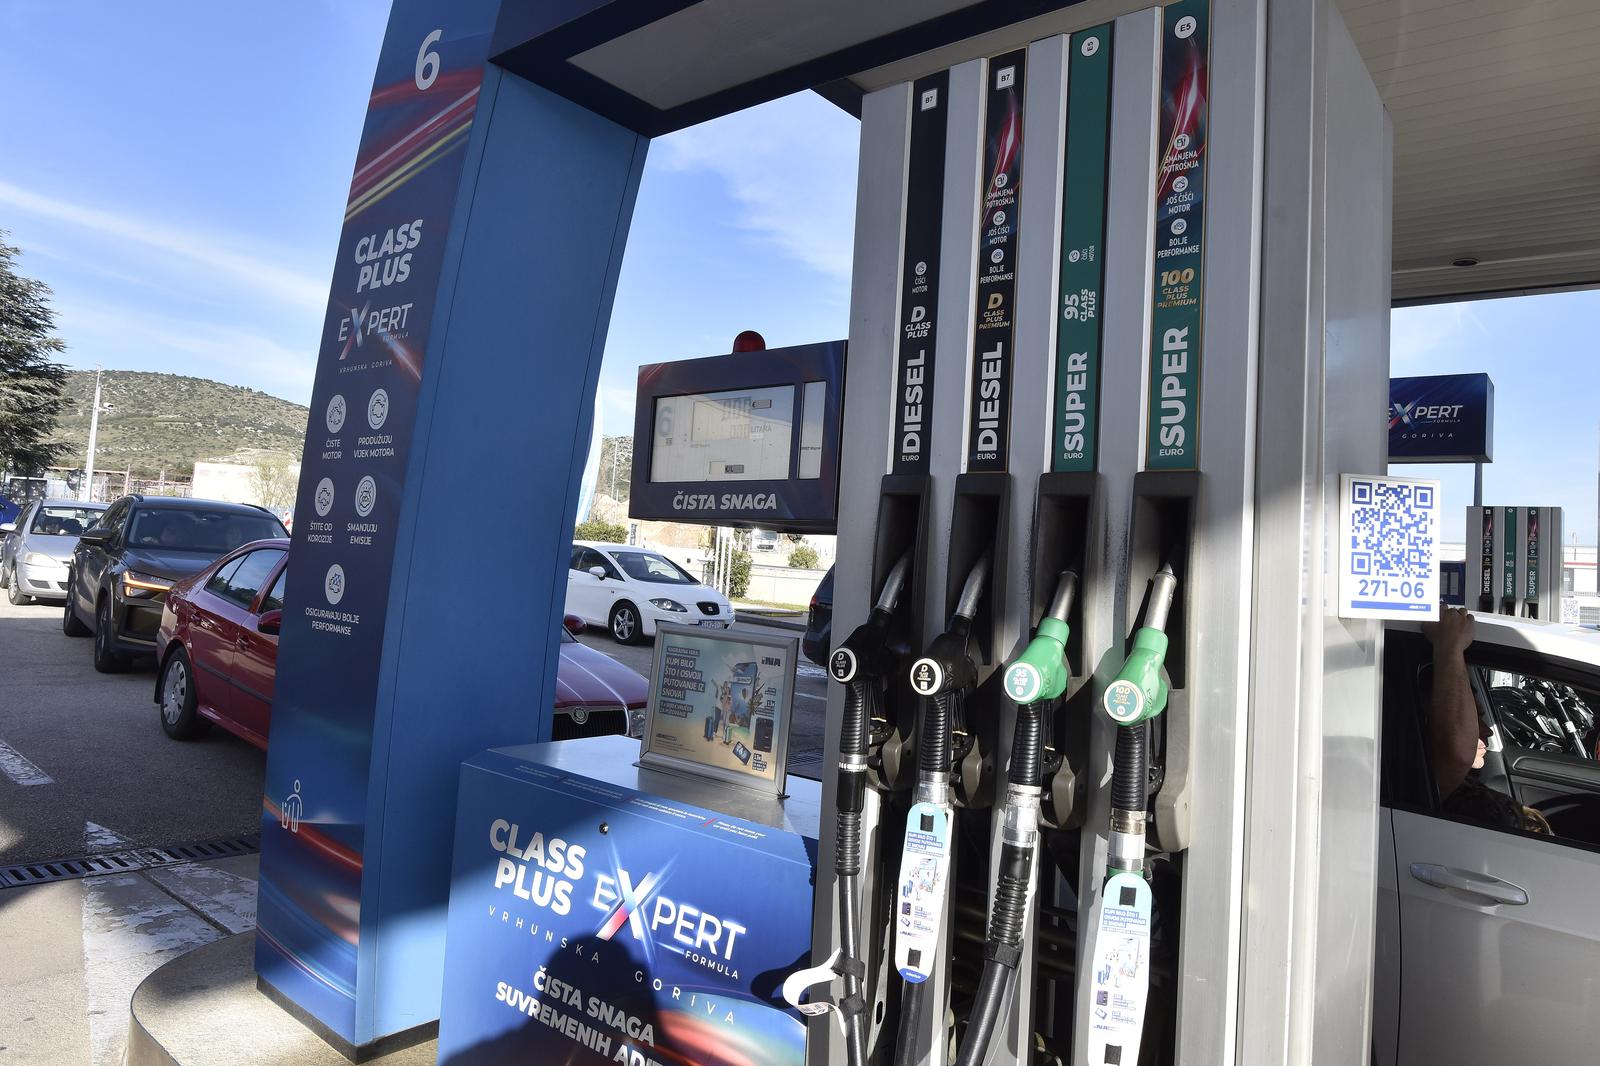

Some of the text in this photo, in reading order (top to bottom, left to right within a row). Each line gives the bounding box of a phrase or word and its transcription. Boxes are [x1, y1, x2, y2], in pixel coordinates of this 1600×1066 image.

[1180, 23, 1191, 32] E5
[415, 30, 442, 90] 6
[1001, 74, 1010, 82] B7
[1165, 151, 1198, 164] SMANJENA
[1163, 160, 1199, 173] POTROŠNJA
[987, 189, 1013, 200] SMANJENA
[1166, 195, 1178, 205] JOŠ
[986, 197, 1015, 208] POTROŠNJA
[1168, 204, 1191, 214] MOTOR
[988, 228, 998, 237] JOŠ
[355, 220, 423, 264] CLASS
[990, 236, 1007, 245] MOTOR
[1169, 236, 1187, 246] BOLJE
[1158, 245, 1200, 258] PERFORMANSE
[357, 253, 412, 293] PLUS
[990, 264, 1004, 273] BOLJE
[980, 273, 1013, 284] PERFORMANSE
[1161, 268, 1194, 286] 100
[1163, 286, 1190, 295] CLASS
[1166, 292, 1187, 300] PLUS
[988, 293, 1003, 309] D
[1064, 294, 1079, 320] 95
[1080, 289, 1088, 322] CLASS
[1088, 291, 1096, 318] PLUS
[1158, 299, 1196, 309] PREMIUM
[911, 306, 925, 322] D
[905, 322, 931, 332] CLASS
[979, 321, 1010, 329] PREMIUM
[907, 330, 928, 339] PLUS
[1160, 326, 1188, 447] SUPER
[903, 350, 925, 453] DIESEL
[977, 342, 1002, 452] DIESEL
[1065, 352, 1087, 452] SUPER
[326, 438, 341, 448] ČISTE
[358, 434, 392, 446] PRODUŽUJU
[323, 452, 342, 460] MOTOR
[354, 449, 394, 458] VIJEK MOTORA
[673, 490, 777, 510] ČISTA SNAGA
[310, 520, 332, 532] ŠTITE OD
[347, 523, 378, 533] SMANJUJU
[308, 536, 332, 544] KOROZIJE
[350, 536, 371, 545] EMISIJE
[1358, 579, 1425, 598] 271-06
[305, 608, 359, 623] OSIGURAVAJU BOLJE
[312, 621, 351, 635] PERFORMANSE
[681, 660, 694, 668] BILO
[664, 678, 697, 689] PUTOVANJE
[1116, 686, 1130, 694] 100
[490, 819, 586, 880] CLASS
[495, 857, 573, 916] PLUS
[593, 868, 746, 961] EXPERT
[489, 905, 600, 964] VRHUNSKA
[685, 951, 738, 979] FORMULA
[636, 971, 734, 1024] GORIVA
[533, 965, 655, 1047] ČISTA SNAGA
[495, 981, 611, 1059] SUVREMENIH
